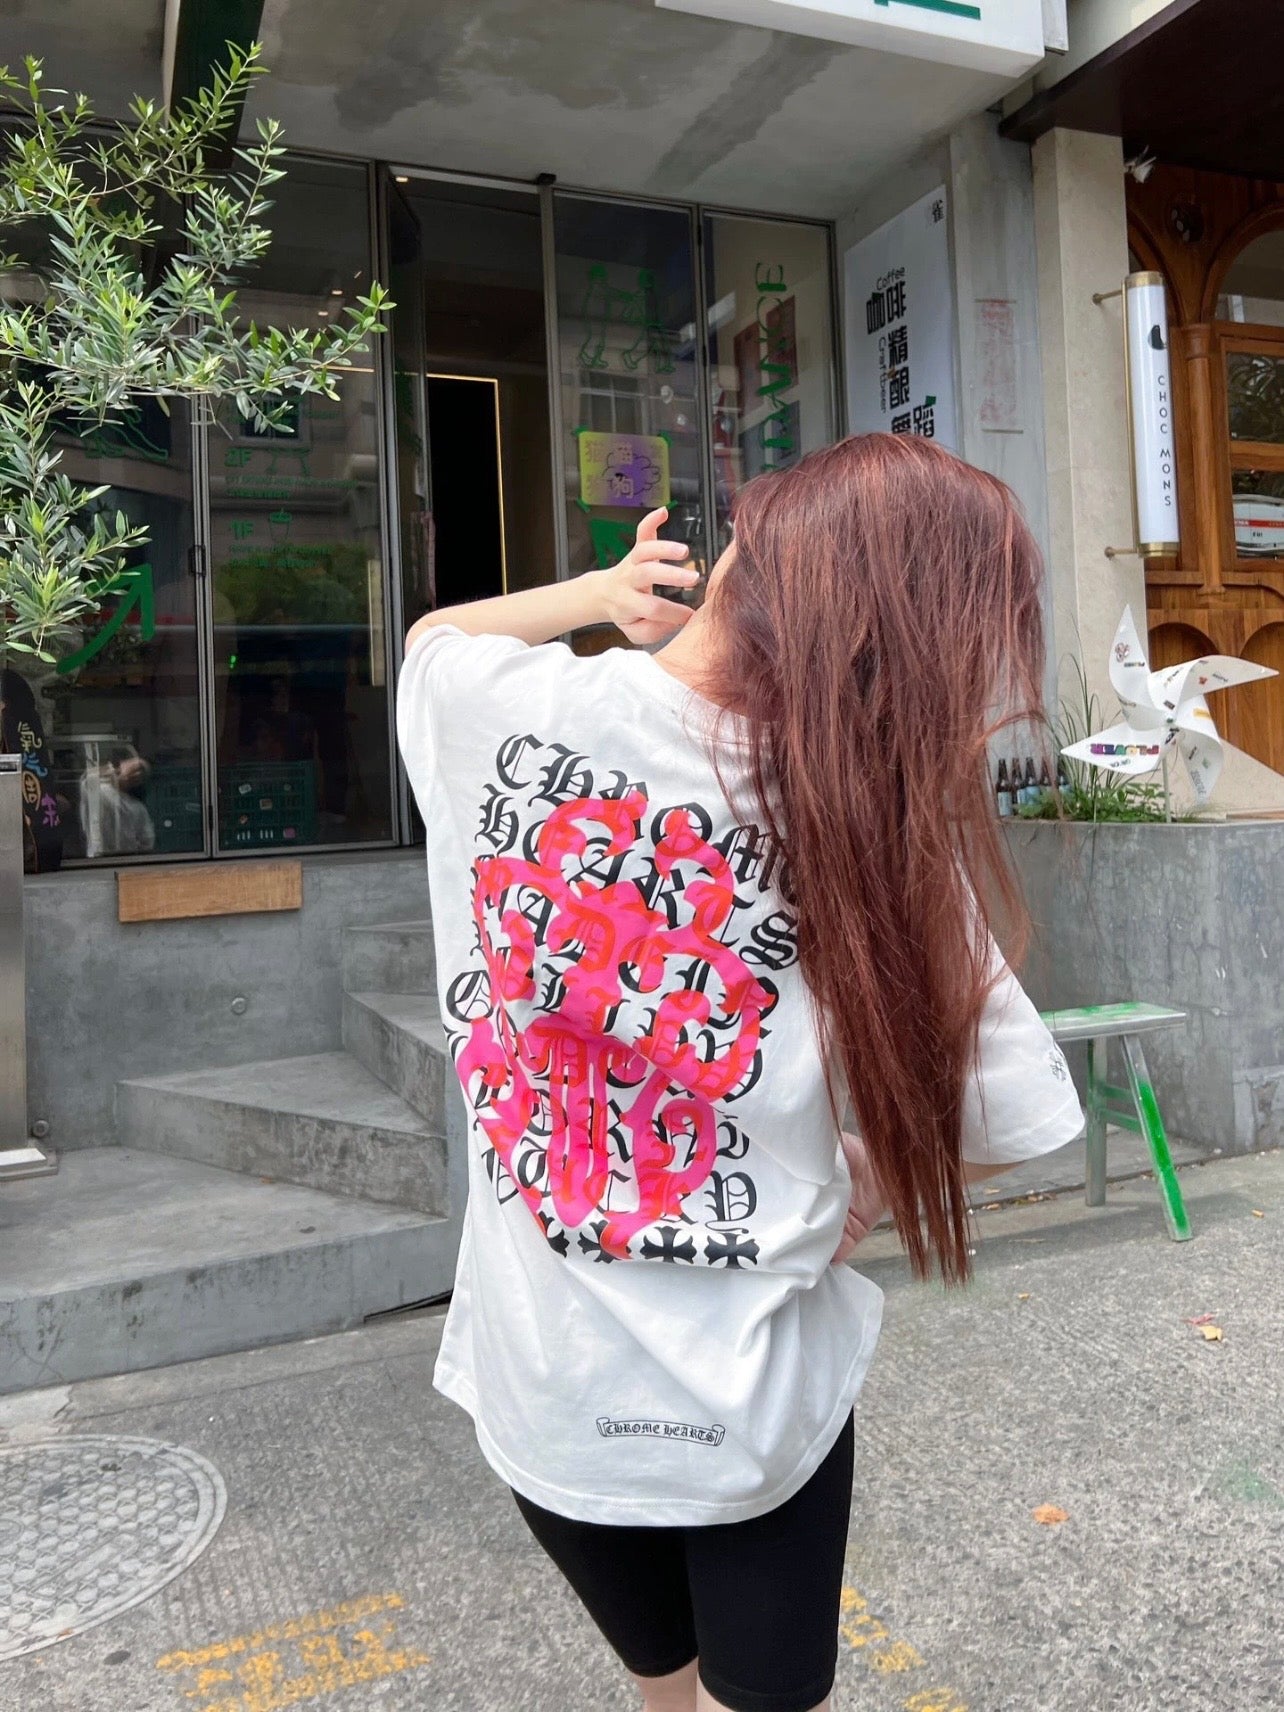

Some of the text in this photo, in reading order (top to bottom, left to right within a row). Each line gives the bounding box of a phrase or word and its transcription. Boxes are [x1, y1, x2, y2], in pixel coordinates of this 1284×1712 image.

[876, 267, 906, 291] Coffee
[866, 281, 907, 335] 咖啡
[1157, 375, 1172, 507] CHOC MONS
[605, 1423, 715, 1443] CHROME HEARTS
